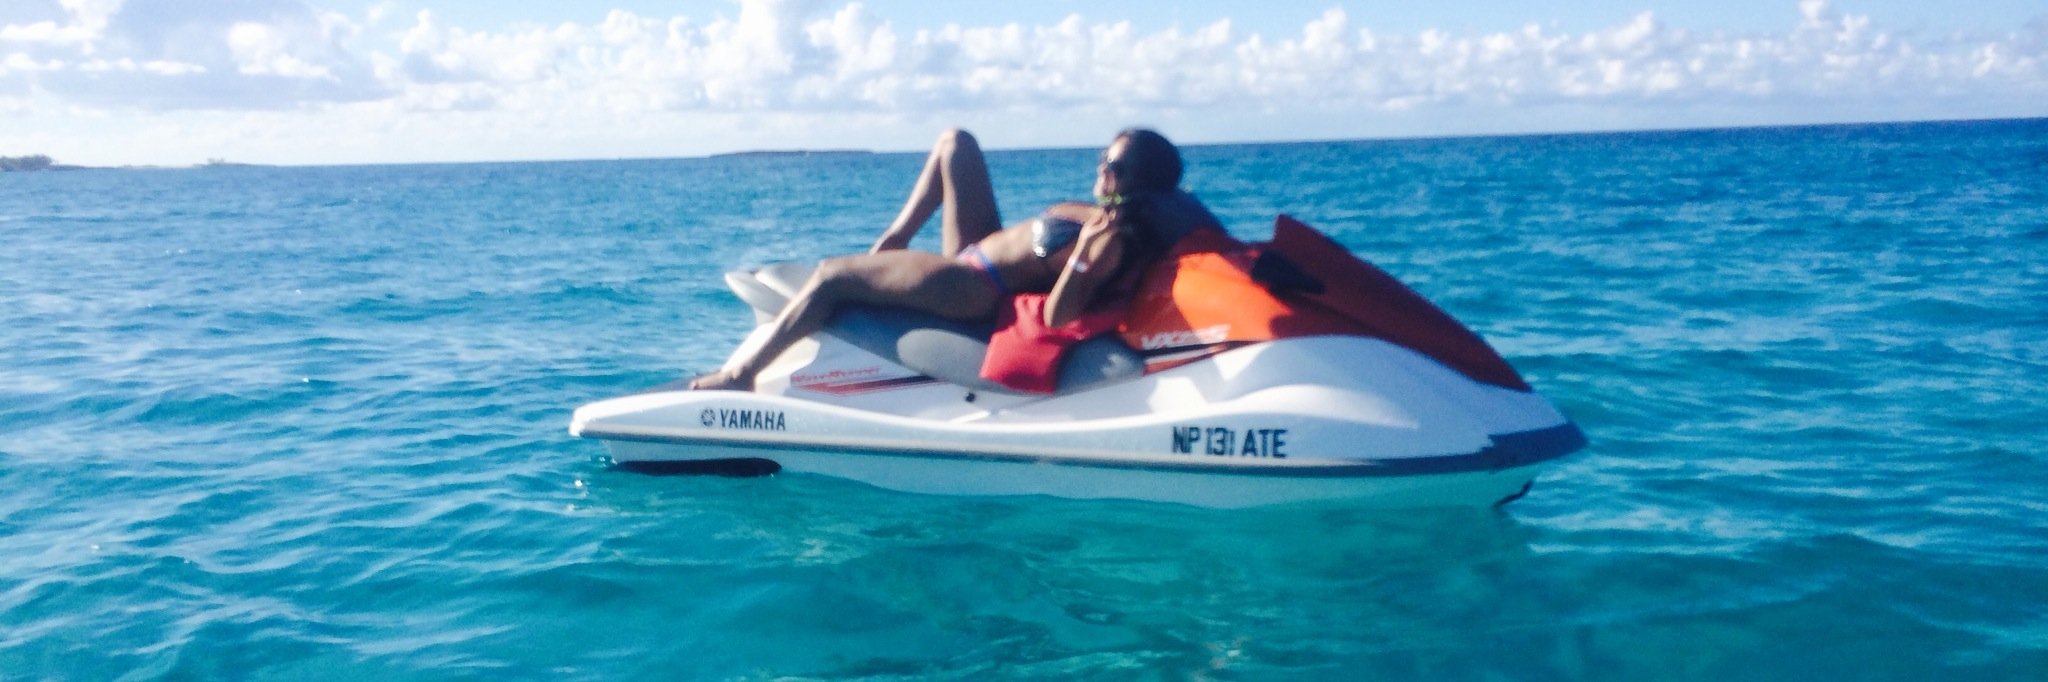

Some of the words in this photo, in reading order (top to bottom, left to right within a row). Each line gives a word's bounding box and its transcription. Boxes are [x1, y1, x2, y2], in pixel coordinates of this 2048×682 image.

[719, 408, 786, 431] YAMAHA
[1171, 426, 1201, 454] NP
[1205, 427, 1235, 456] 131
[1241, 429, 1288, 458] ATE
